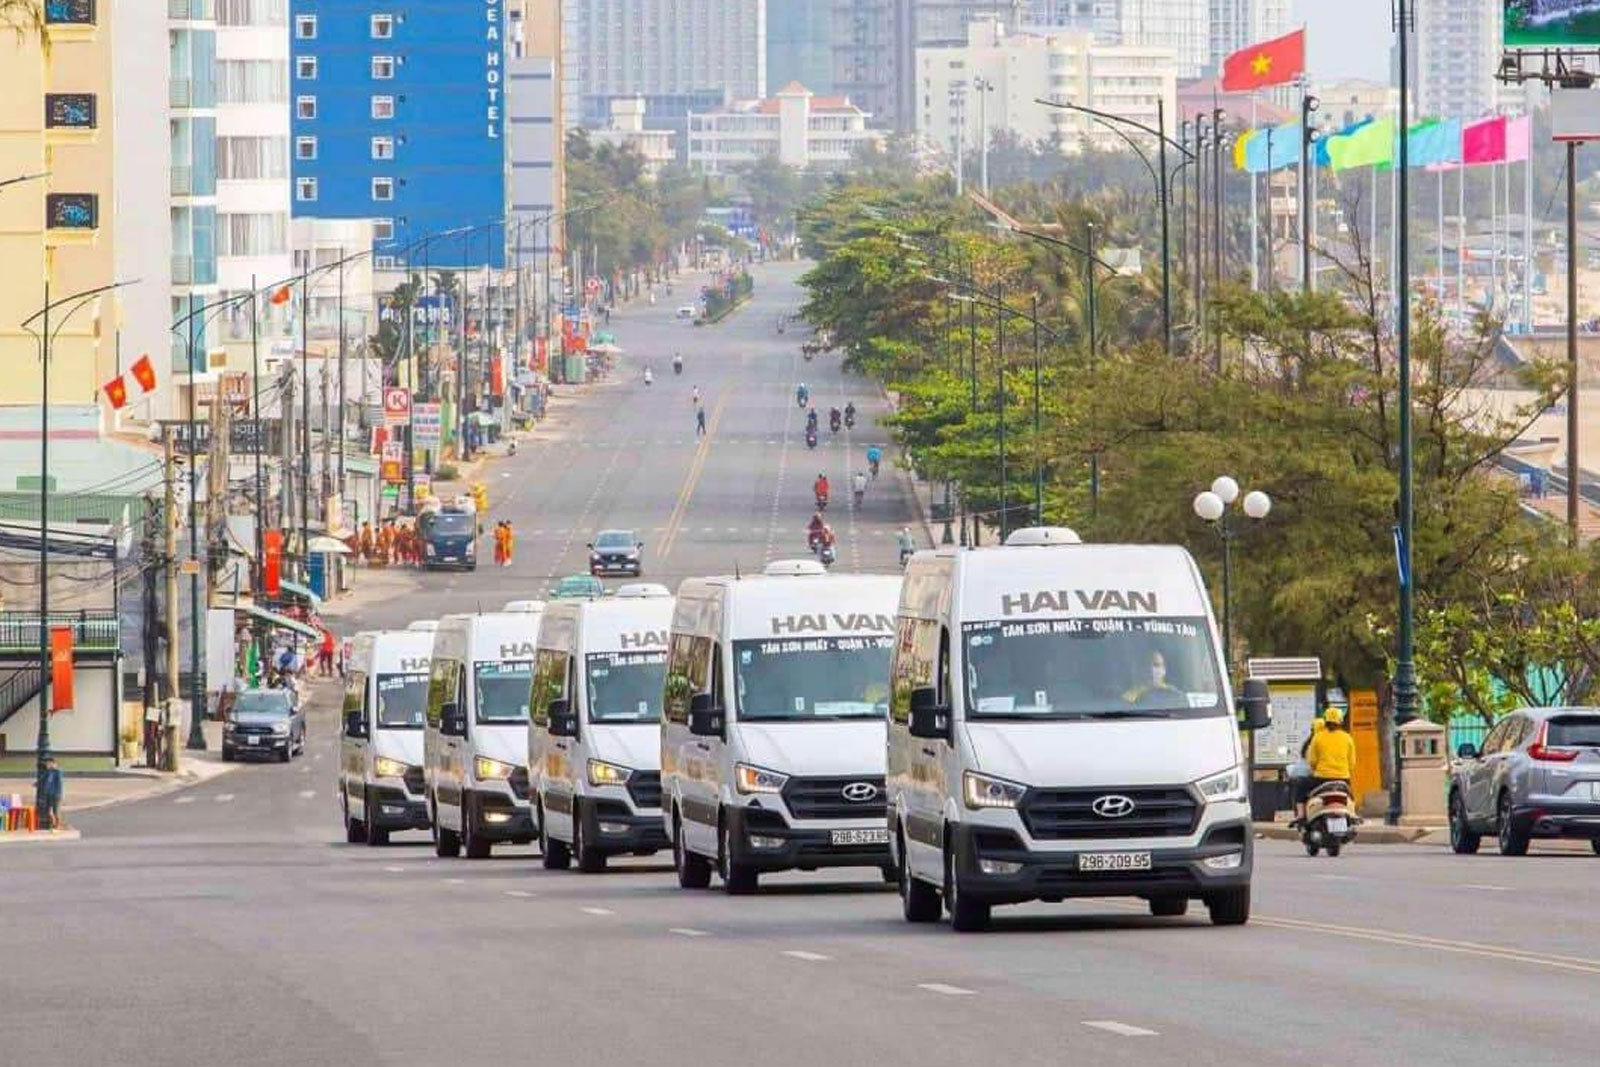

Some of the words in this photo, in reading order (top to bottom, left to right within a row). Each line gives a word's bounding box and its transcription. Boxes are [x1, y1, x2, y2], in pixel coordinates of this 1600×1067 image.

[487, 52, 499, 138] HOTEL
[1002, 591, 1069, 615] HAI
[1075, 590, 1157, 613] VAN
[771, 614, 827, 634] HAI
[501, 644, 535, 657] HA
[401, 659, 430, 671] HA
